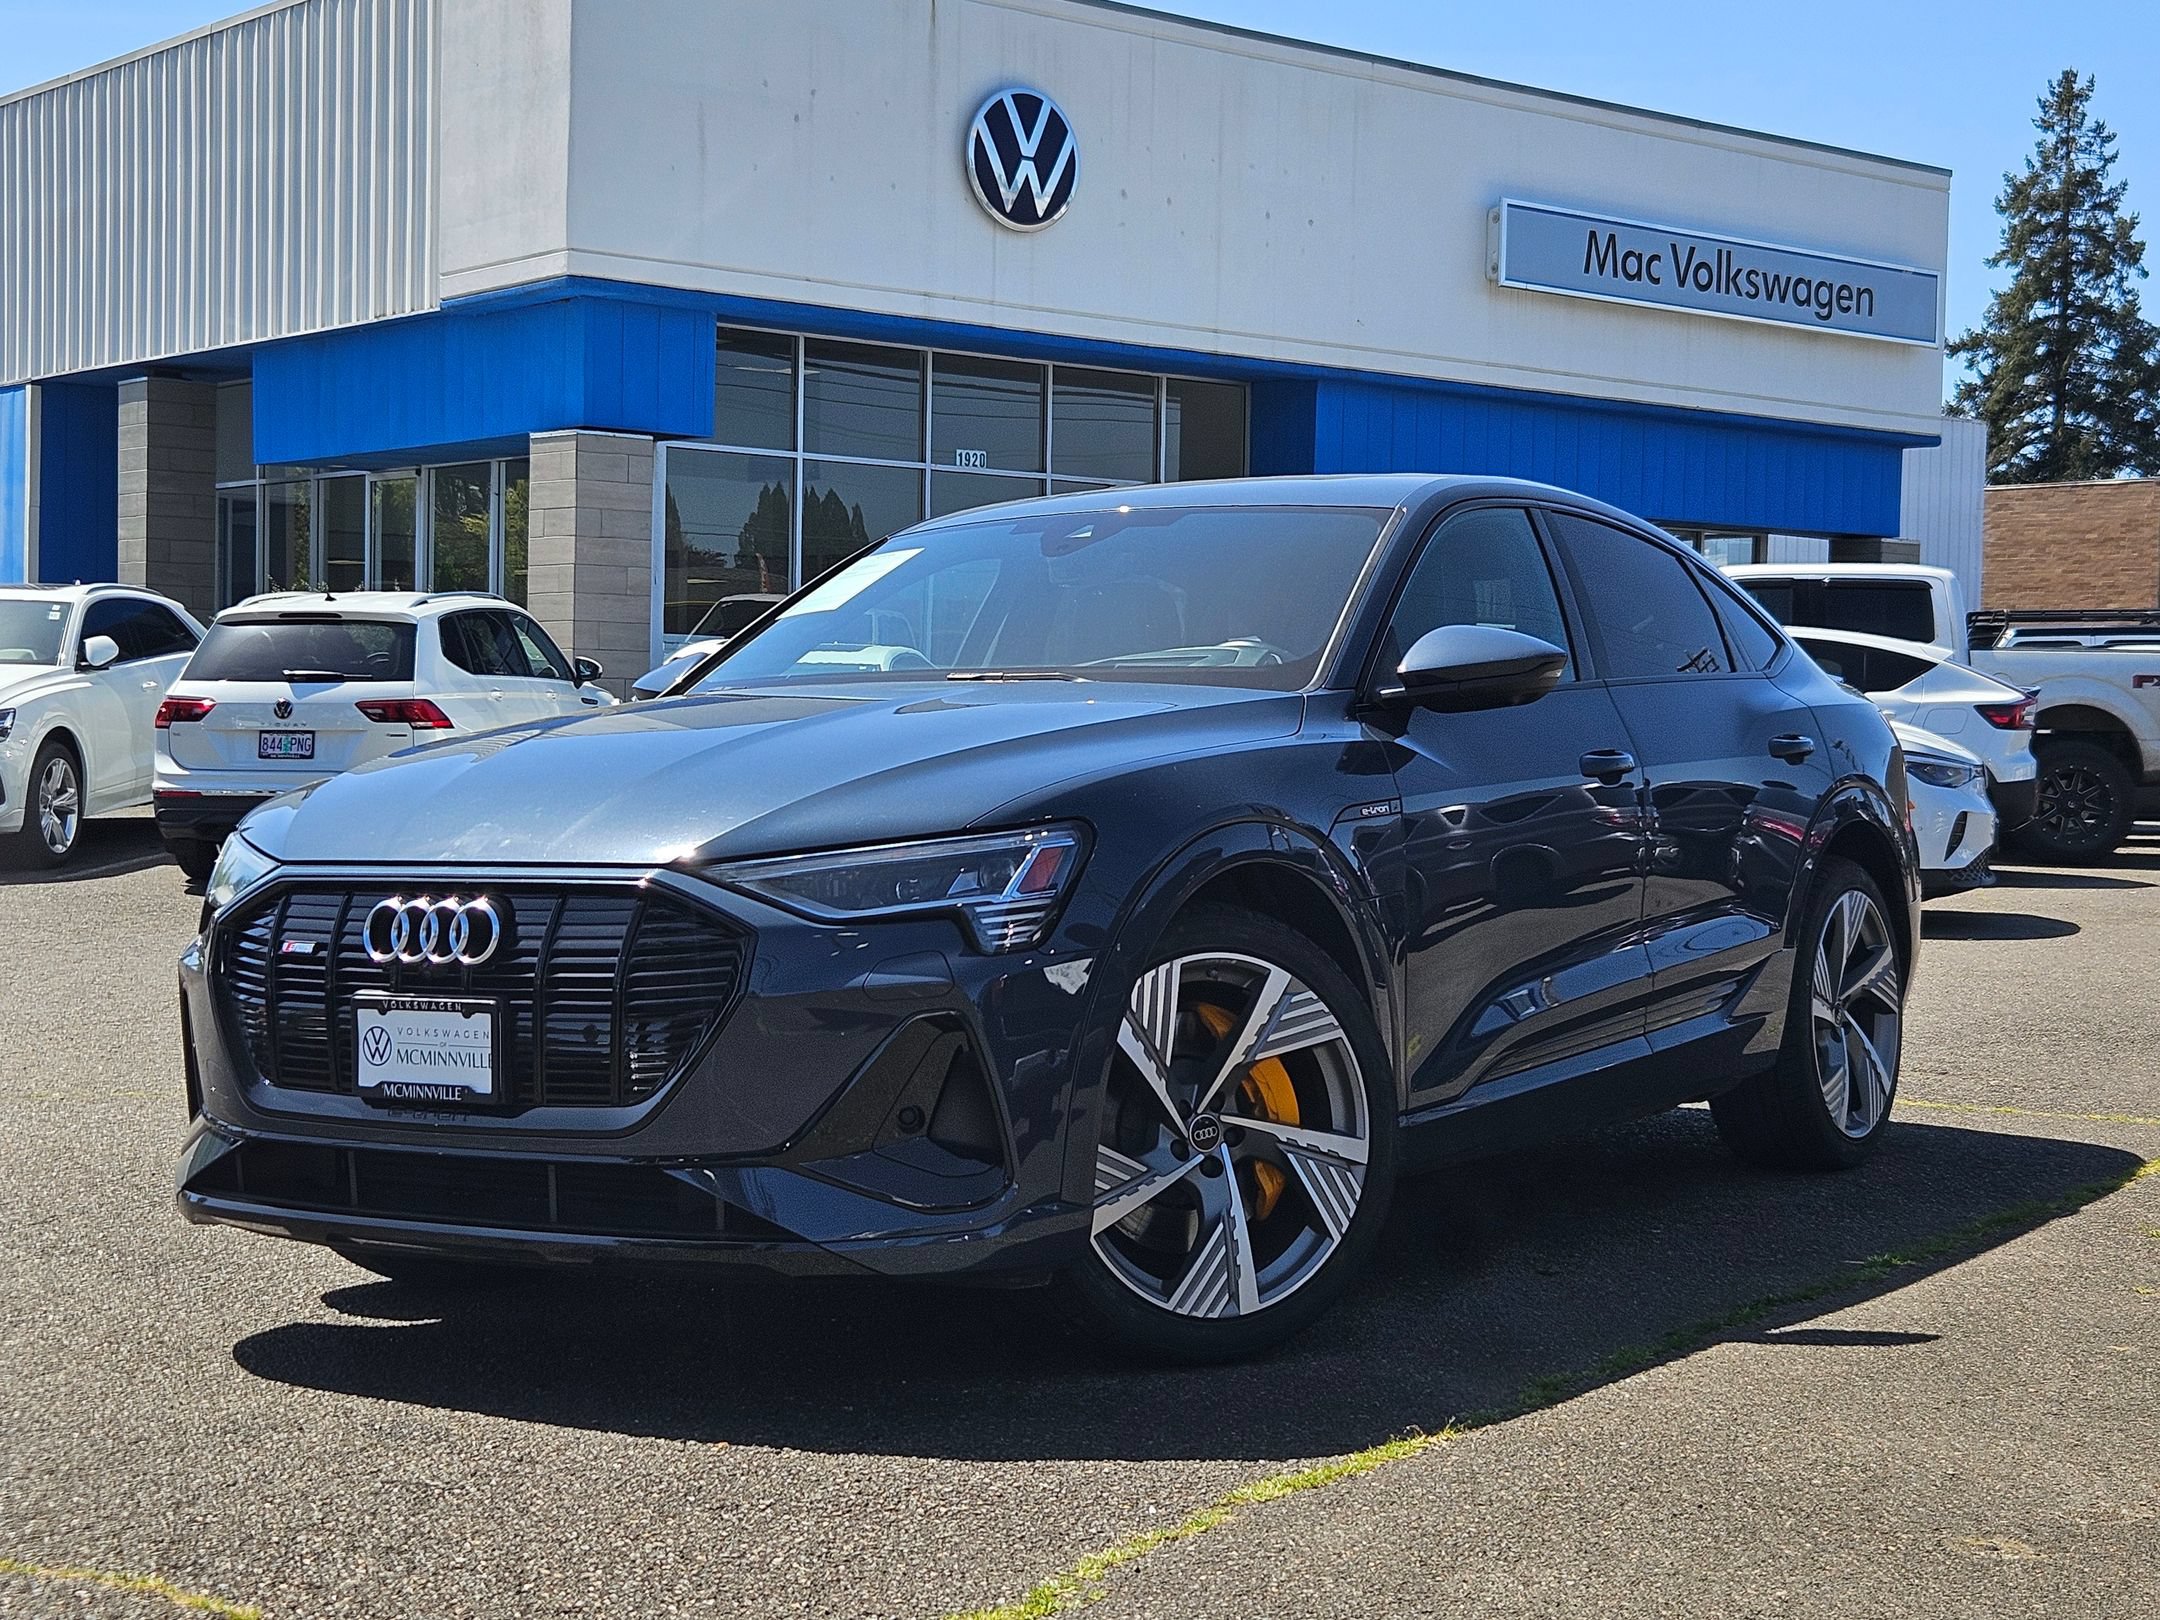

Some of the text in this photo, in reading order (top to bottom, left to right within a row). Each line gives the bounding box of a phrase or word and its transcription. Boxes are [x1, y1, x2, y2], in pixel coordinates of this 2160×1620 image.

[1583, 230, 1874, 321] Mac Volkswagen
[958, 452, 986, 468] 1920
[262, 737, 312, 752] 844 PNG
[1362, 804, 1389, 816] e-tron
[382, 1000, 462, 1011] VOLKSWAGEN
[397, 1027, 490, 1040] VOLKSWAGEN
[383, 1083, 462, 1101] MCMINNVILLE
